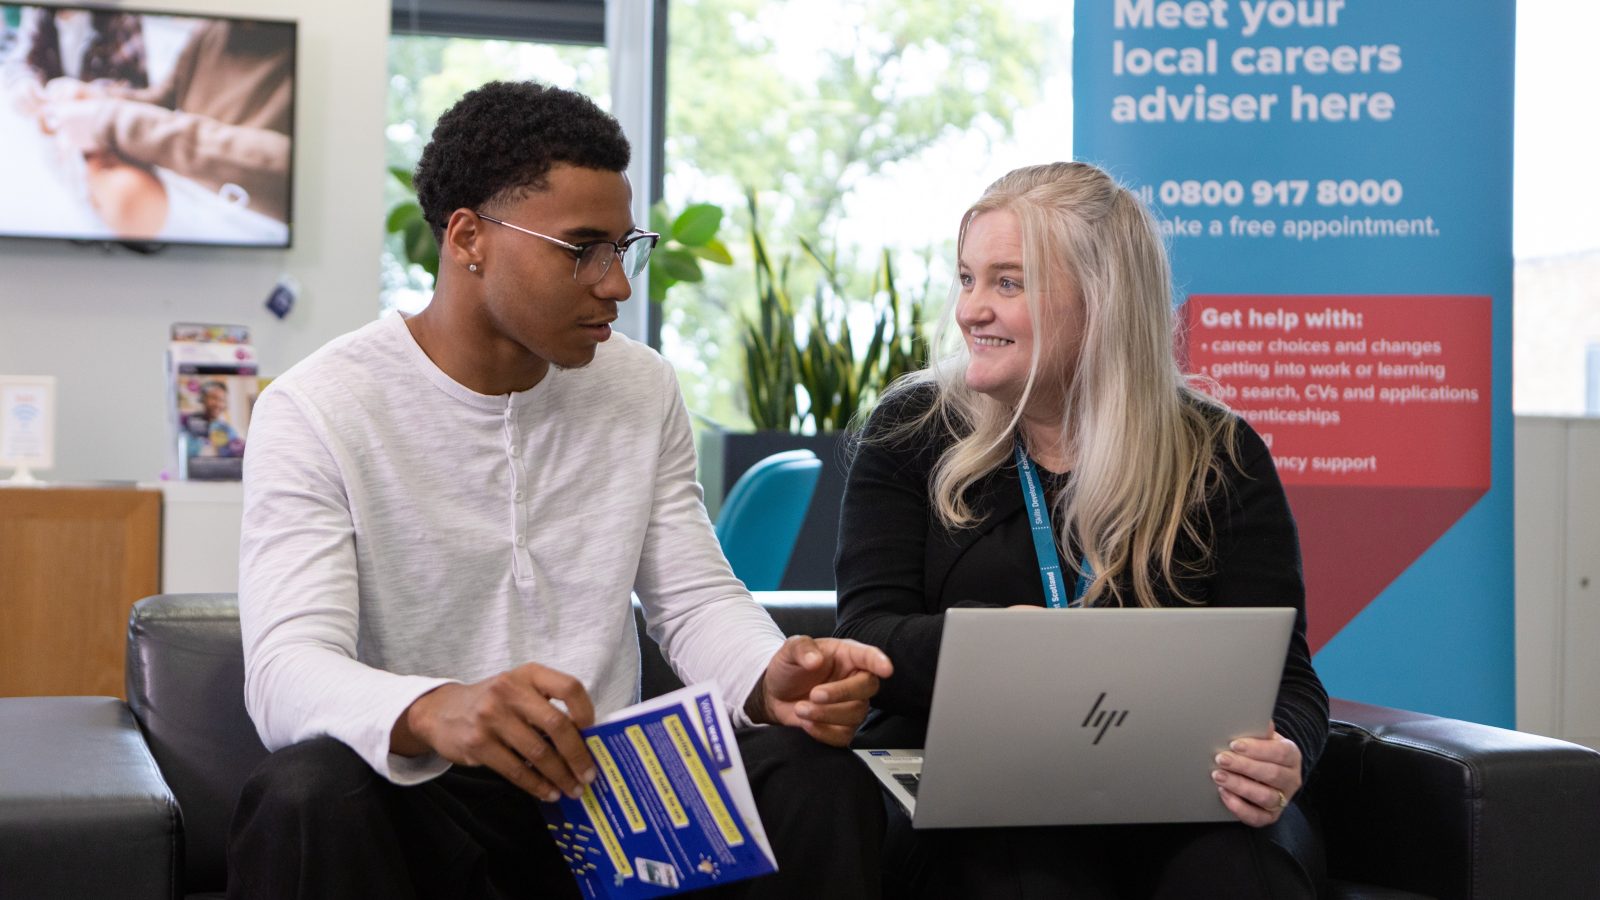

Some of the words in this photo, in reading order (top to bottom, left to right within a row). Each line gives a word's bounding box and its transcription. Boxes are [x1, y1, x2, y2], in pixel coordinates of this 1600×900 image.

[1114, 0, 1229, 28] Meet
[1241, 0, 1345, 36] your
[1113, 39, 1217, 75] local
[1231, 42, 1403, 74] careers
[1111, 85, 1278, 121] adviser
[1291, 85, 1396, 121] here
[1160, 180, 1244, 206] 0800
[1251, 180, 1309, 206] 917
[1316, 179, 1403, 206] 8000
[1161, 215, 1203, 237] ake
[1209, 219, 1223, 236] a
[1230, 215, 1276, 236] free
[1283, 214, 1440, 240] appointment.
[1201, 308, 1242, 328] Get
[1249, 308, 1298, 331] help
[1305, 308, 1364, 328] with:
[1212, 340, 1263, 354] career
[1268, 338, 1331, 354] choices
[1335, 338, 1367, 354] and
[1371, 338, 1442, 358] changes
[1212, 361, 1270, 380] getting
[1274, 361, 1306, 377] into
[1310, 361, 1351, 377] work
[1356, 365, 1373, 377] or
[1378, 361, 1446, 381] learning
[1241, 384, 1301, 401] search,
[1304, 384, 1339, 400] CVs
[1344, 385, 1375, 401] and
[1379, 385, 1480, 404] applications
[1312, 455, 1377, 474] support
[1046, 571, 1060, 602] Scotland
[700, 697, 715, 726] Who
[1081, 692, 1129, 745] hp
